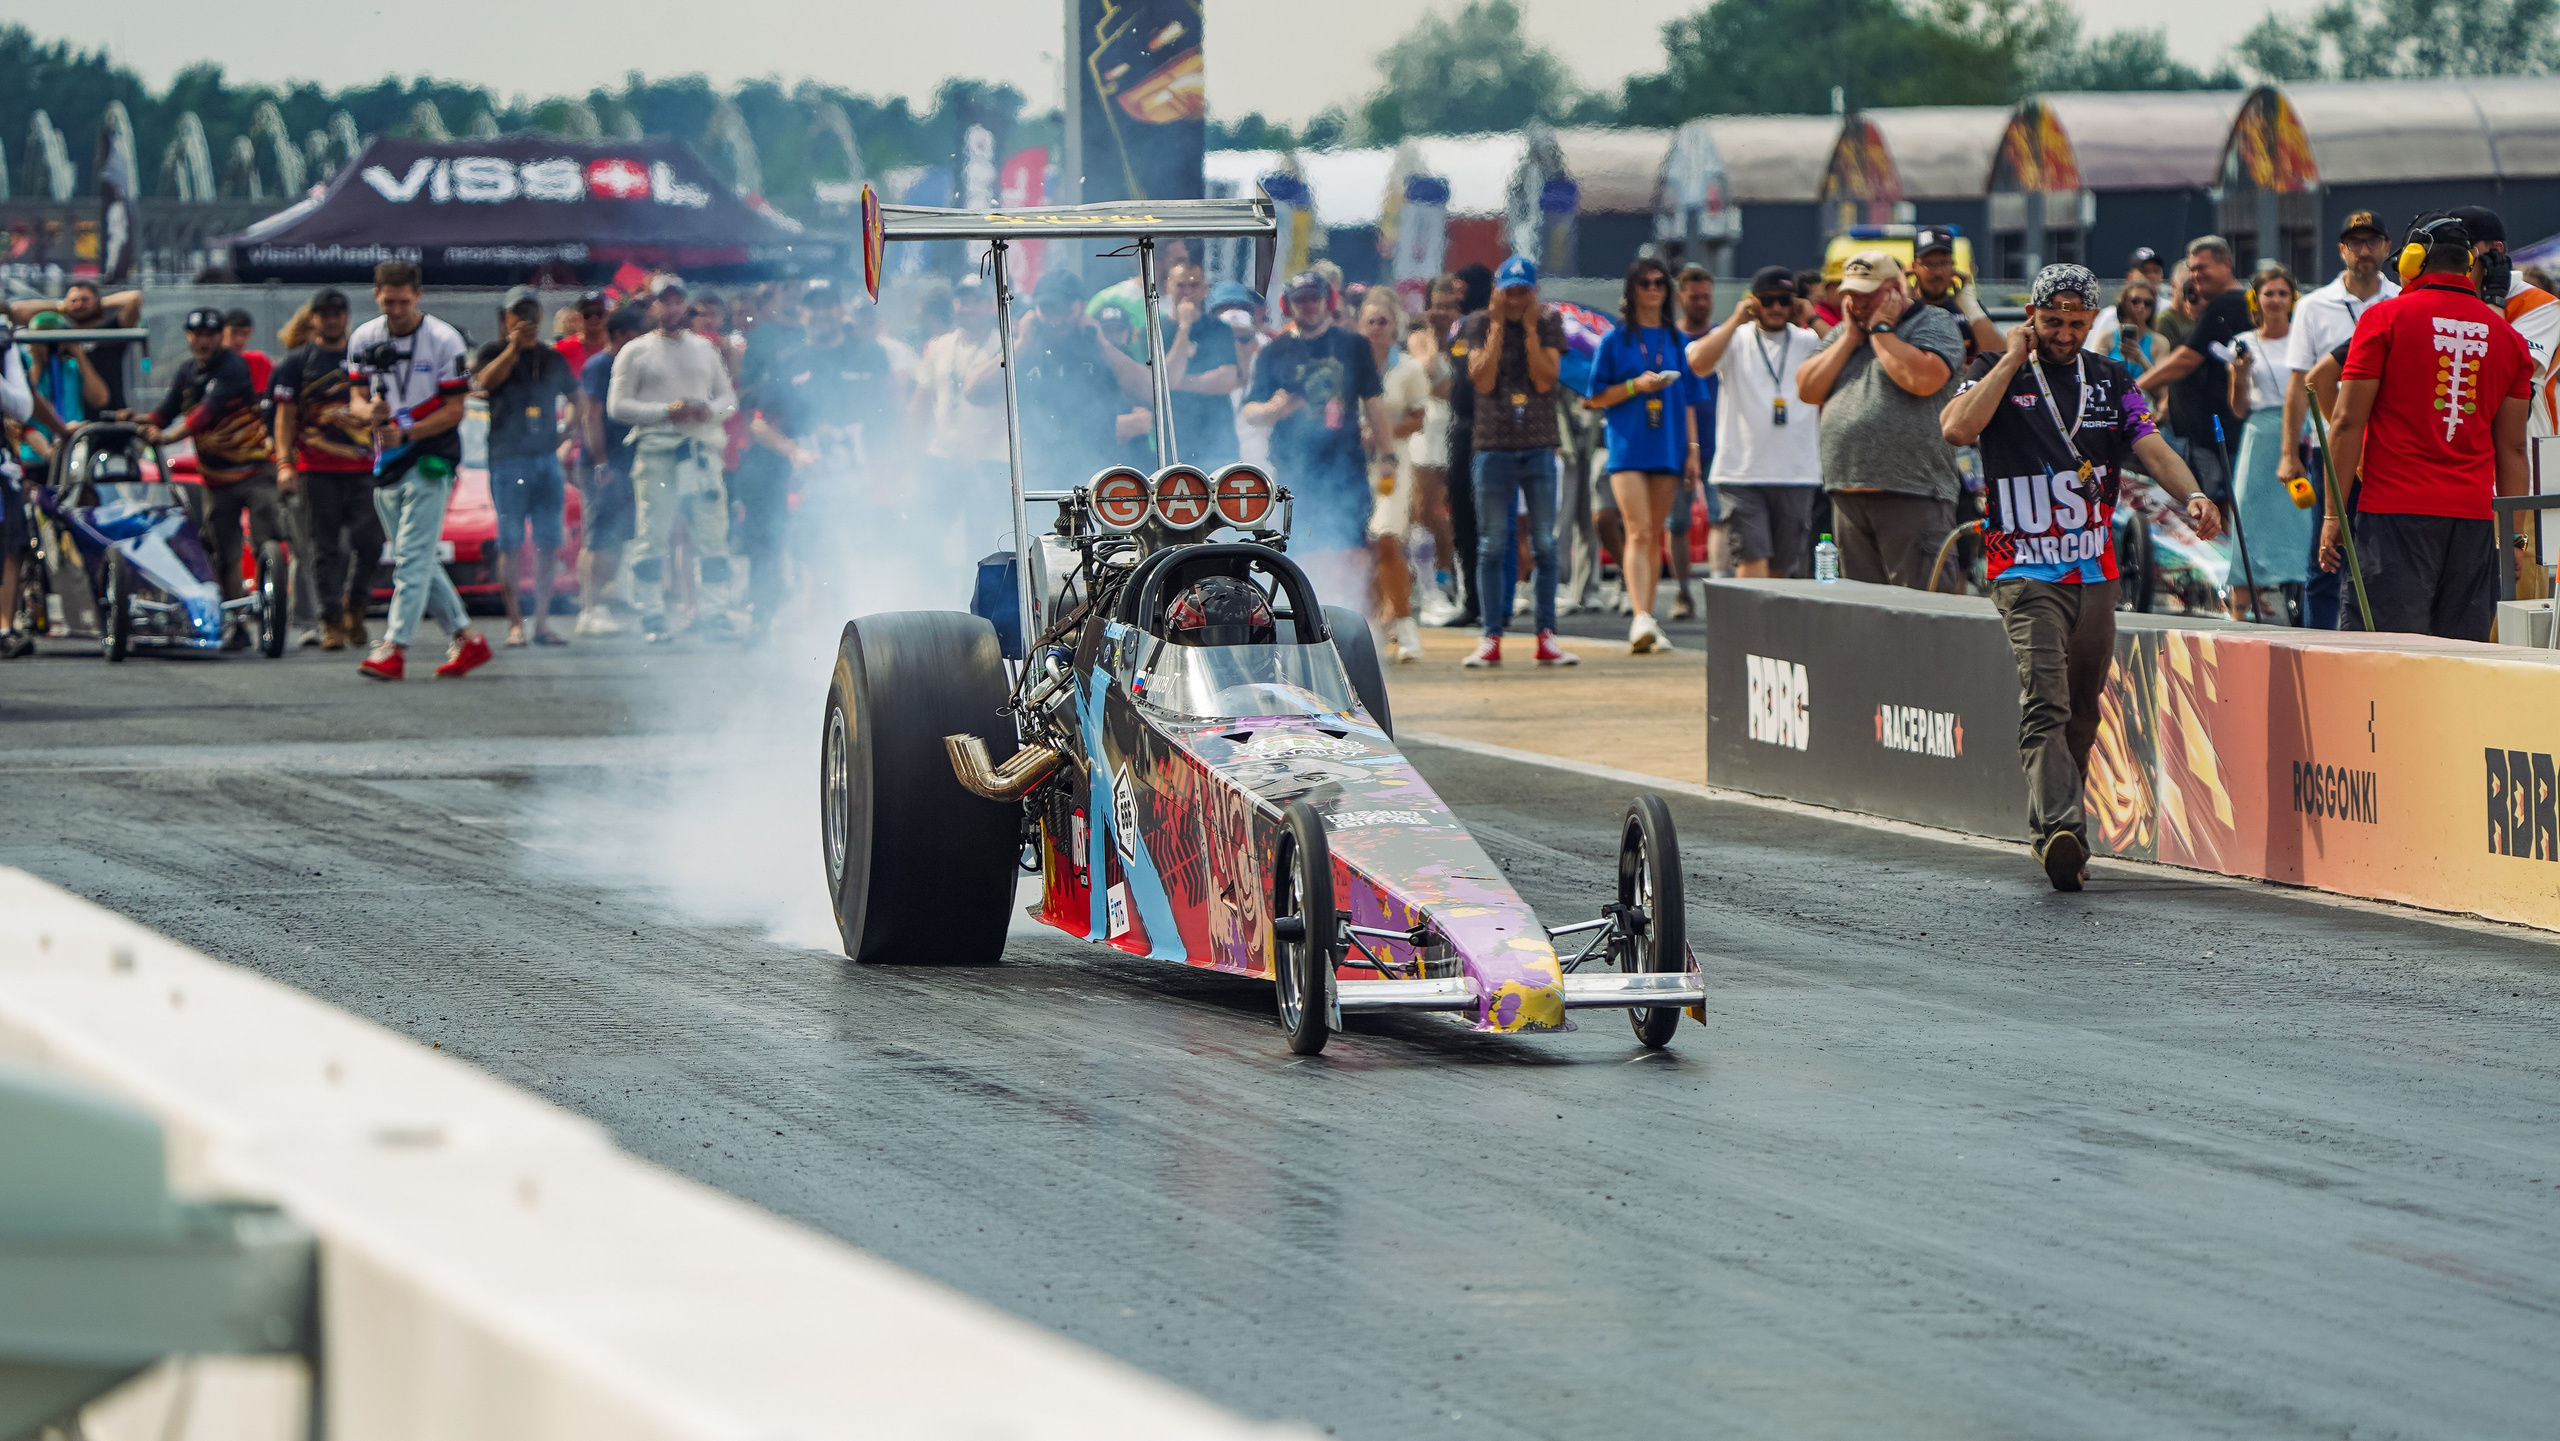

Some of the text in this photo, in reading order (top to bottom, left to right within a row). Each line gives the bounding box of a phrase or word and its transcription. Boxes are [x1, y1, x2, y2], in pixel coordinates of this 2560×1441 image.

[1101, 478, 1255, 522] GAT
[1747, 653, 1809, 752] RDRC
[1881, 703, 1956, 758] RACEPARK
[2293, 760, 2377, 824] ROSGONKI
[2484, 747, 2560, 863] RDR
